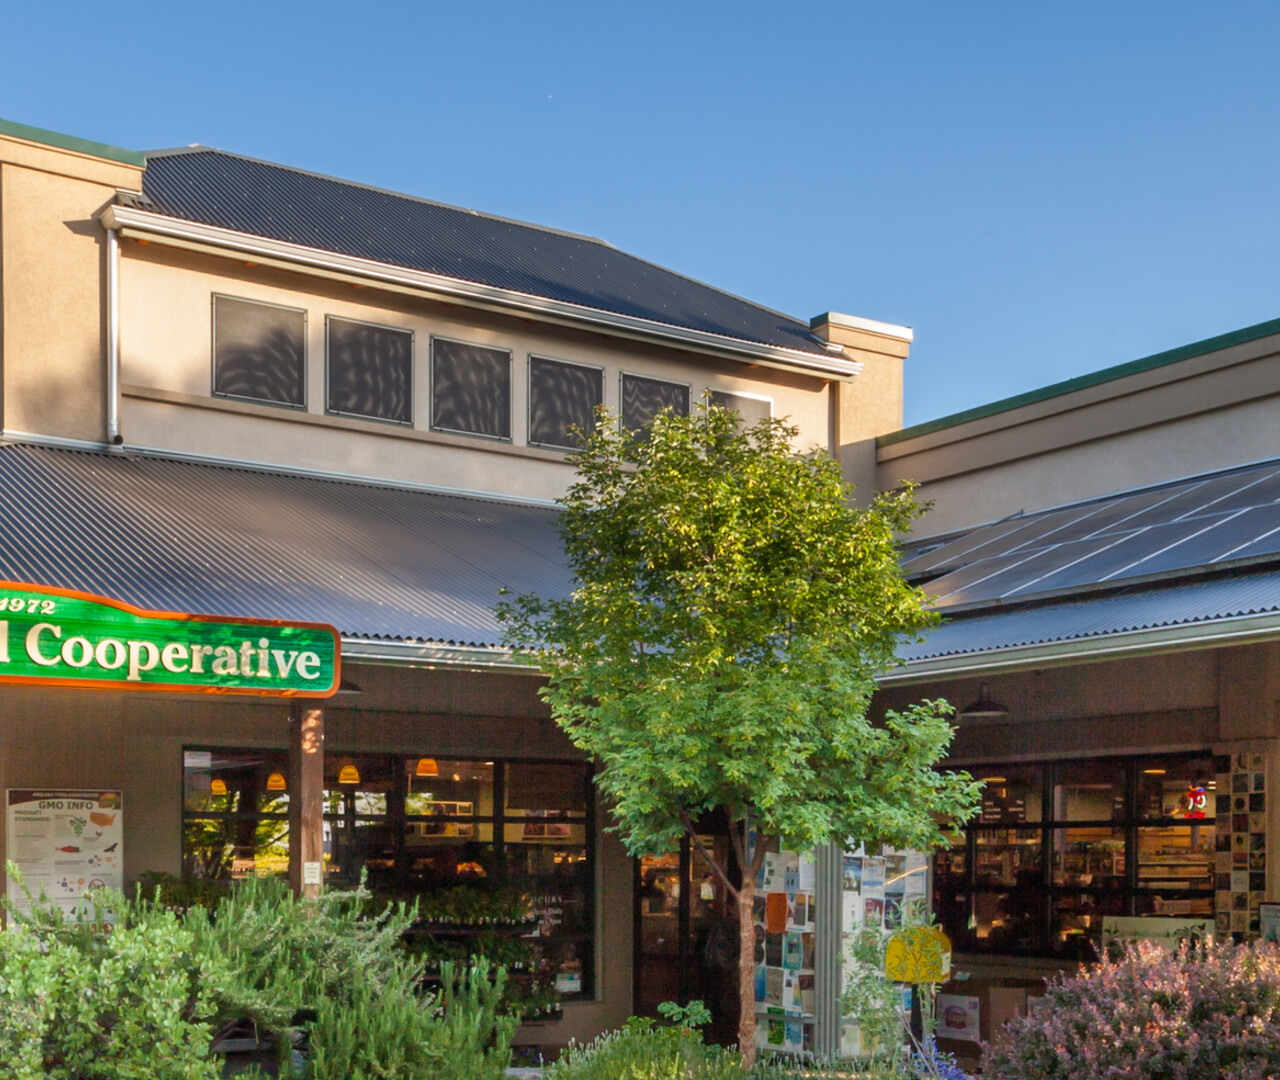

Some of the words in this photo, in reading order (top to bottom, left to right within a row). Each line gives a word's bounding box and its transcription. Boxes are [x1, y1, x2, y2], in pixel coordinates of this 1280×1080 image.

[25, 622, 321, 681] Cooperative
[38, 801, 64, 810] GMO
[67, 801, 94, 810] INFO
